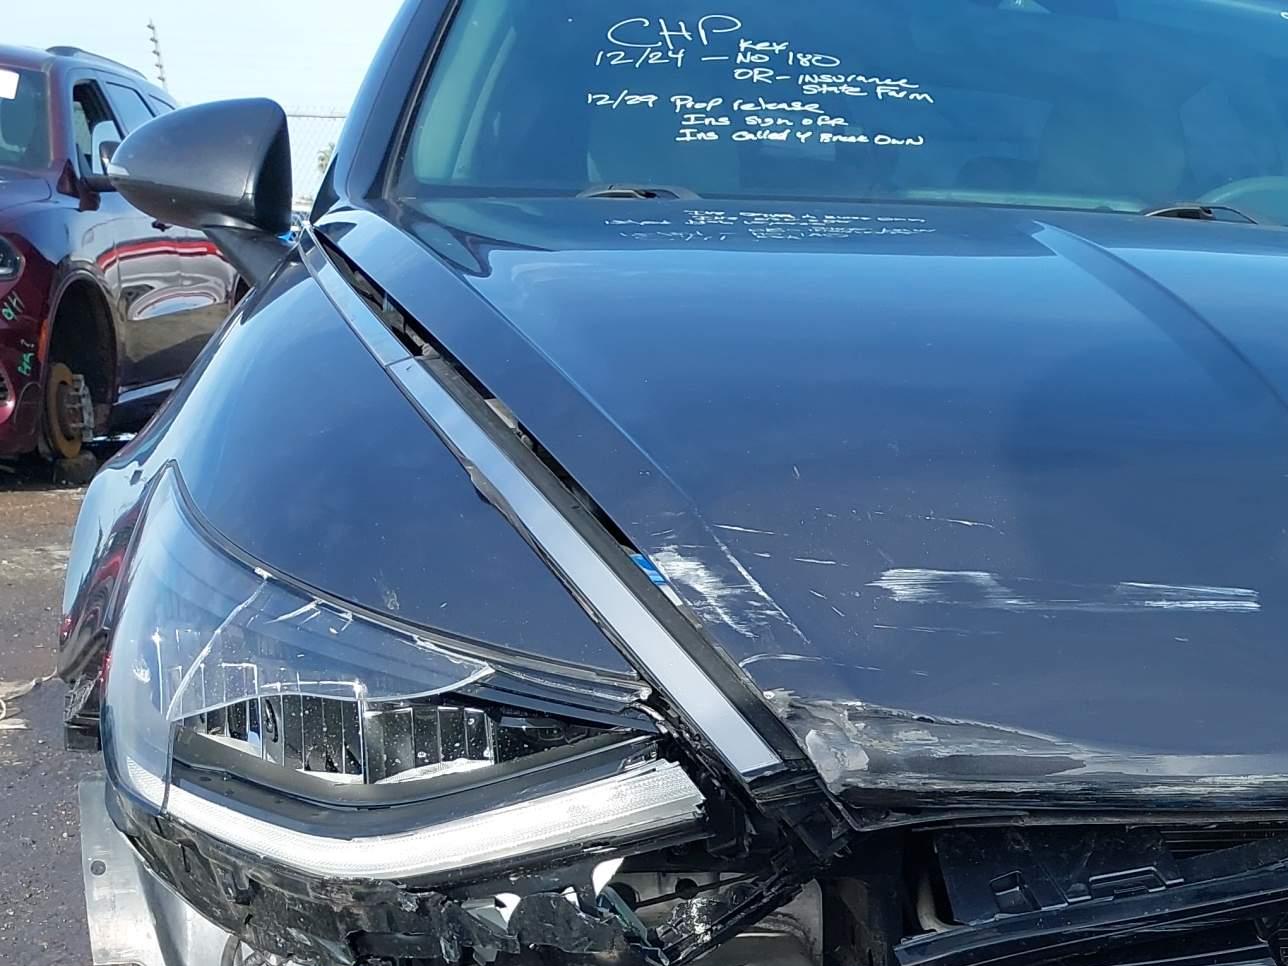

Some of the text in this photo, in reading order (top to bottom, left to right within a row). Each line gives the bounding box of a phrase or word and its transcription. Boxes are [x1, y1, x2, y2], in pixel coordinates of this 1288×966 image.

[607, 15, 742, 49] CHP
[595, 48, 685, 68] 12/24
[788, 51, 840, 67] 180
[587, 90, 658, 109] 12/29
[681, 114, 731, 126] Ins
[675, 128, 719, 141] Ins
